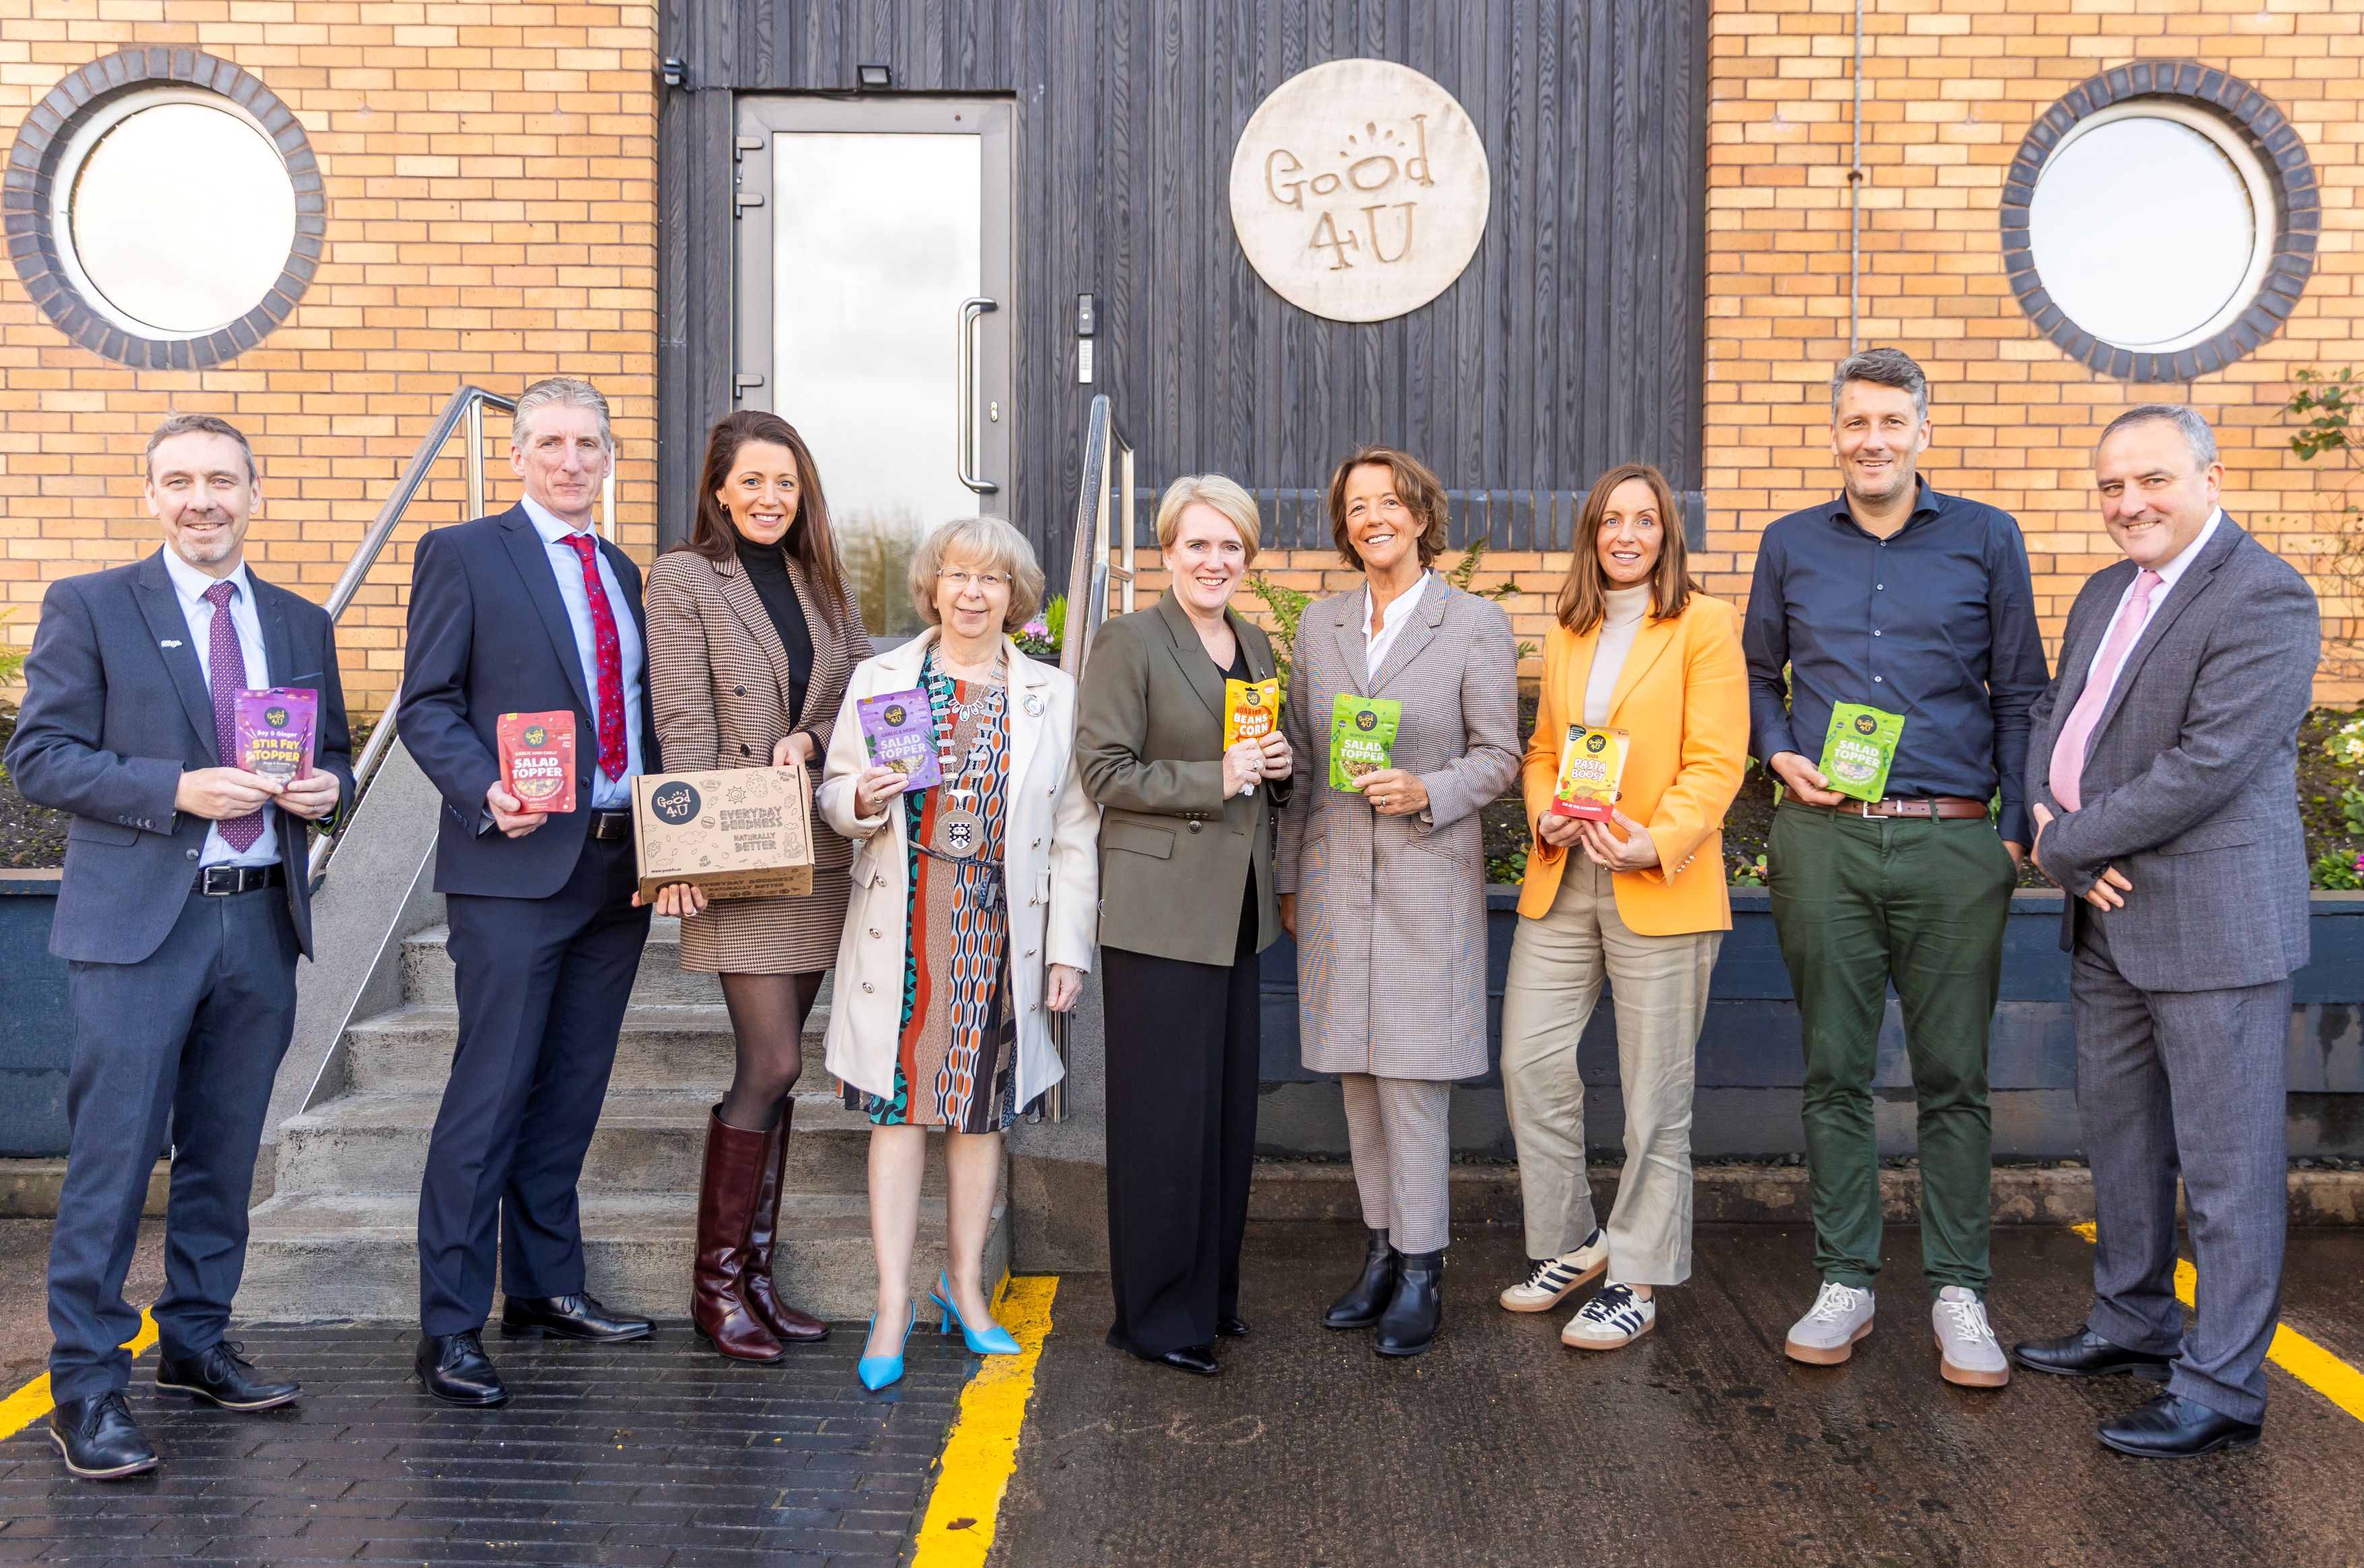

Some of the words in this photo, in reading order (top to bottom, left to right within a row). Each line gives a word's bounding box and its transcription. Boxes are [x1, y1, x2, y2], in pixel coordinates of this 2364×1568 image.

[1264, 113, 1435, 212] Good
[1233, 712, 1268, 724] BEANS
[1236, 707, 1262, 715] ROASTED
[1239, 722, 1268, 736] CORN
[252, 738, 278, 749] STIR
[280, 739, 301, 750] FRY
[880, 734, 921, 750] SALAD
[1344, 739, 1381, 752] SALAD
[1839, 739, 1879, 757] SALAD
[253, 749, 301, 762] TOPPER
[879, 743, 927, 760] TOPPER
[1340, 748, 1384, 761] TOPPER
[1834, 748, 1881, 769] TOPPER
[514, 757, 559, 769] SALAD
[1574, 757, 1607, 773] PASTA
[511, 767, 563, 779] TOPPER
[1571, 767, 1606, 783] BOOST
[657, 788, 691, 808] Good
[666, 803, 689, 817] 4U
[720, 805, 782, 820] EVERYDAY
[720, 816, 783, 832] GOODNESS
[734, 832, 776, 842] NATURALLY
[735, 840, 777, 852] BETTER
[749, 876, 795, 884] GOODNESS
